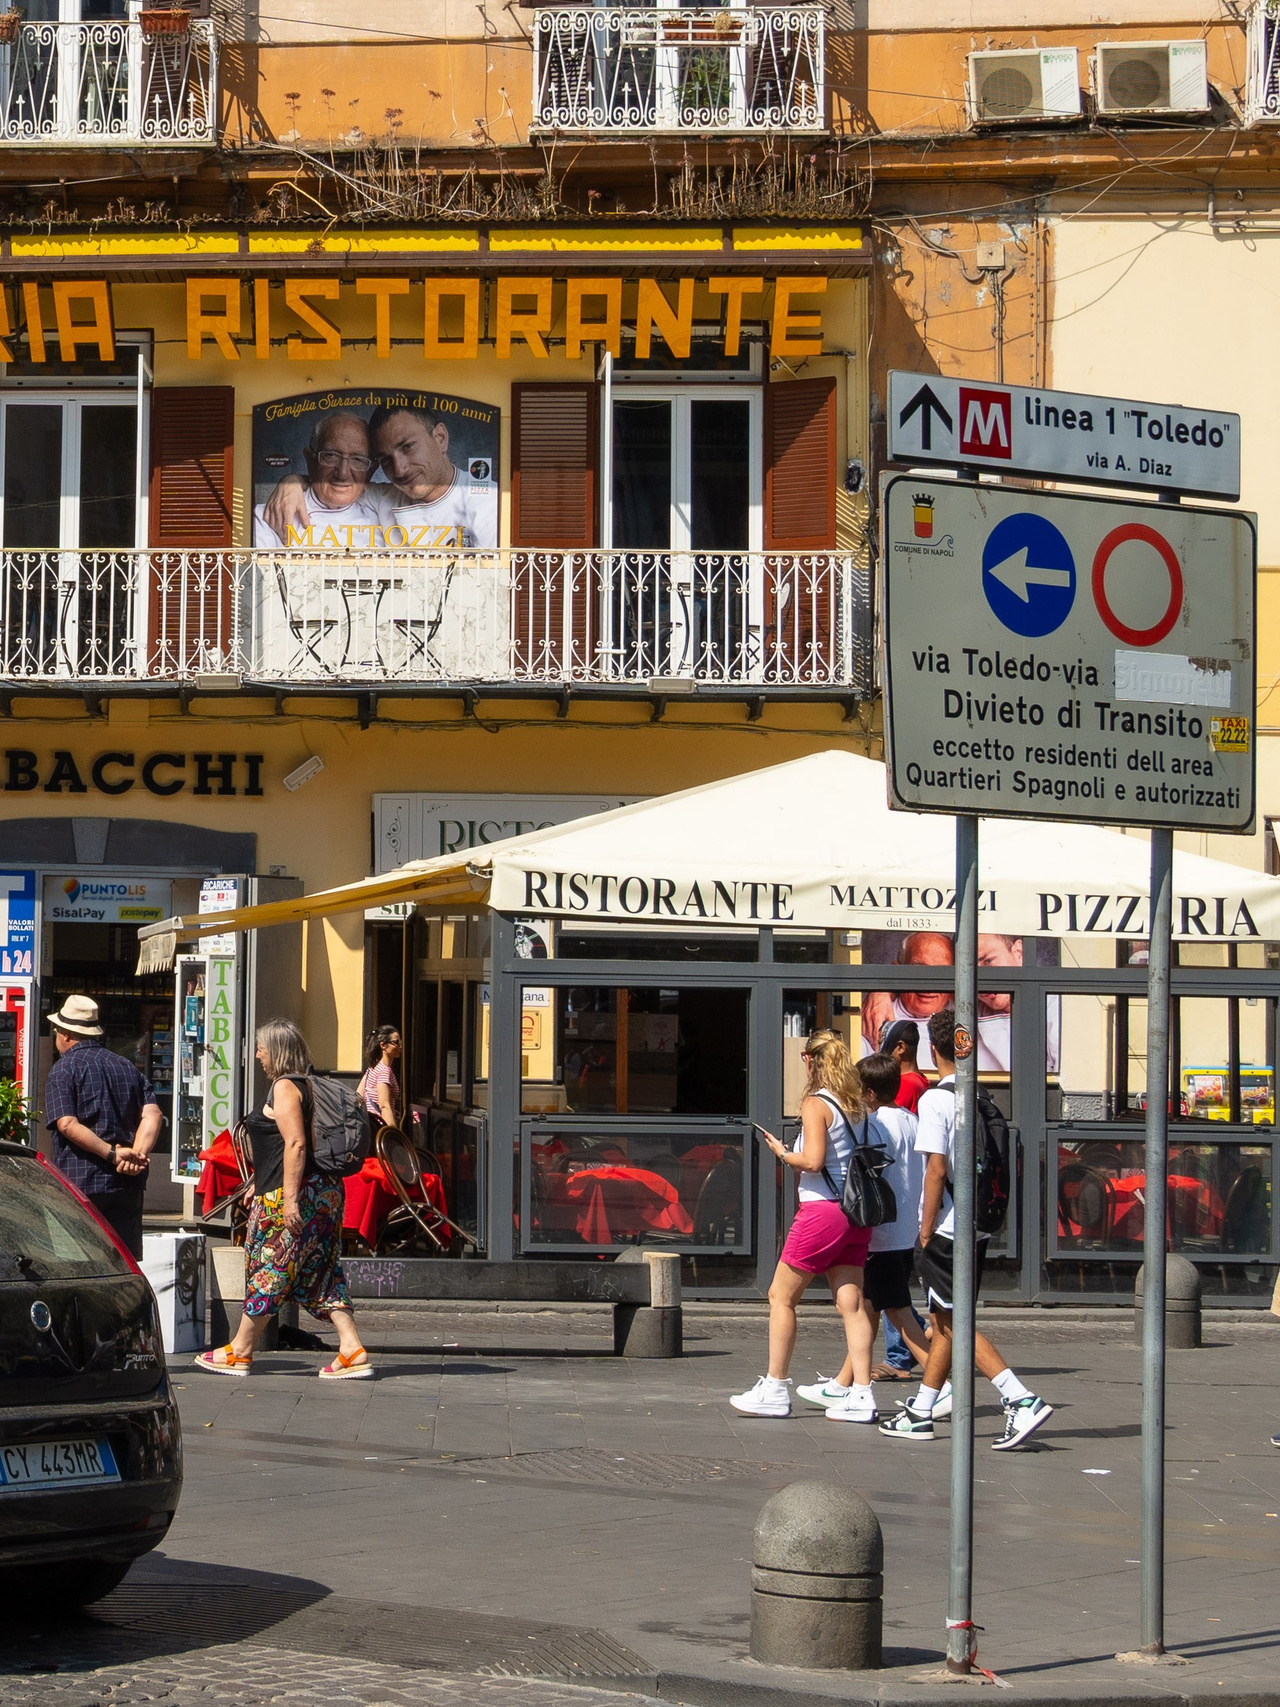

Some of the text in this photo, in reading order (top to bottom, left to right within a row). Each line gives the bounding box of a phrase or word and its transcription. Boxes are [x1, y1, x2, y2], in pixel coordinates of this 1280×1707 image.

[185, 275, 827, 360] RISTORANTE
[265, 392, 493, 424] Famiglia Surace da più di 100 anni
[1024, 396, 1094, 433] linea
[1105, 407, 1115, 435] 1
[1123, 409, 1230, 449] "Toledo"
[1086, 453, 1172, 477] via A. Diaz
[284, 524, 466, 548] MATTOZZI
[894, 545, 922, 555] COMUNE
[931, 549, 954, 557] NAPOLI
[912, 645, 950, 674] via
[962, 647, 1099, 687] Toledo-via
[943, 688, 1203, 740] Divieto di Transito
[1220, 718, 1246, 728] TAXI
[932, 737, 1015, 762] eccetto
[1025, 742, 1117, 770] residenti
[1170, 756, 1214, 777] area
[906, 761, 1241, 810] Quartieri Spagnoli e autorizzati
[438, 819, 558, 856] RIS
[81, 883, 146, 896] PUNTOLIS
[203, 880, 234, 890] RICARICHE
[52, 907, 161, 921] SisalPay postepay
[522, 869, 795, 921] RISTORANTE
[1036, 892, 1261, 937] PIZZRIA
[886, 918, 932, 929] dal 1833
[2, 951, 12, 973] h
[13, 950, 32, 973] 24
[208, 960, 233, 1147] TABACC
[4, 1446, 31, 1480] CY
[41, 1441, 102, 1476] 443MR
